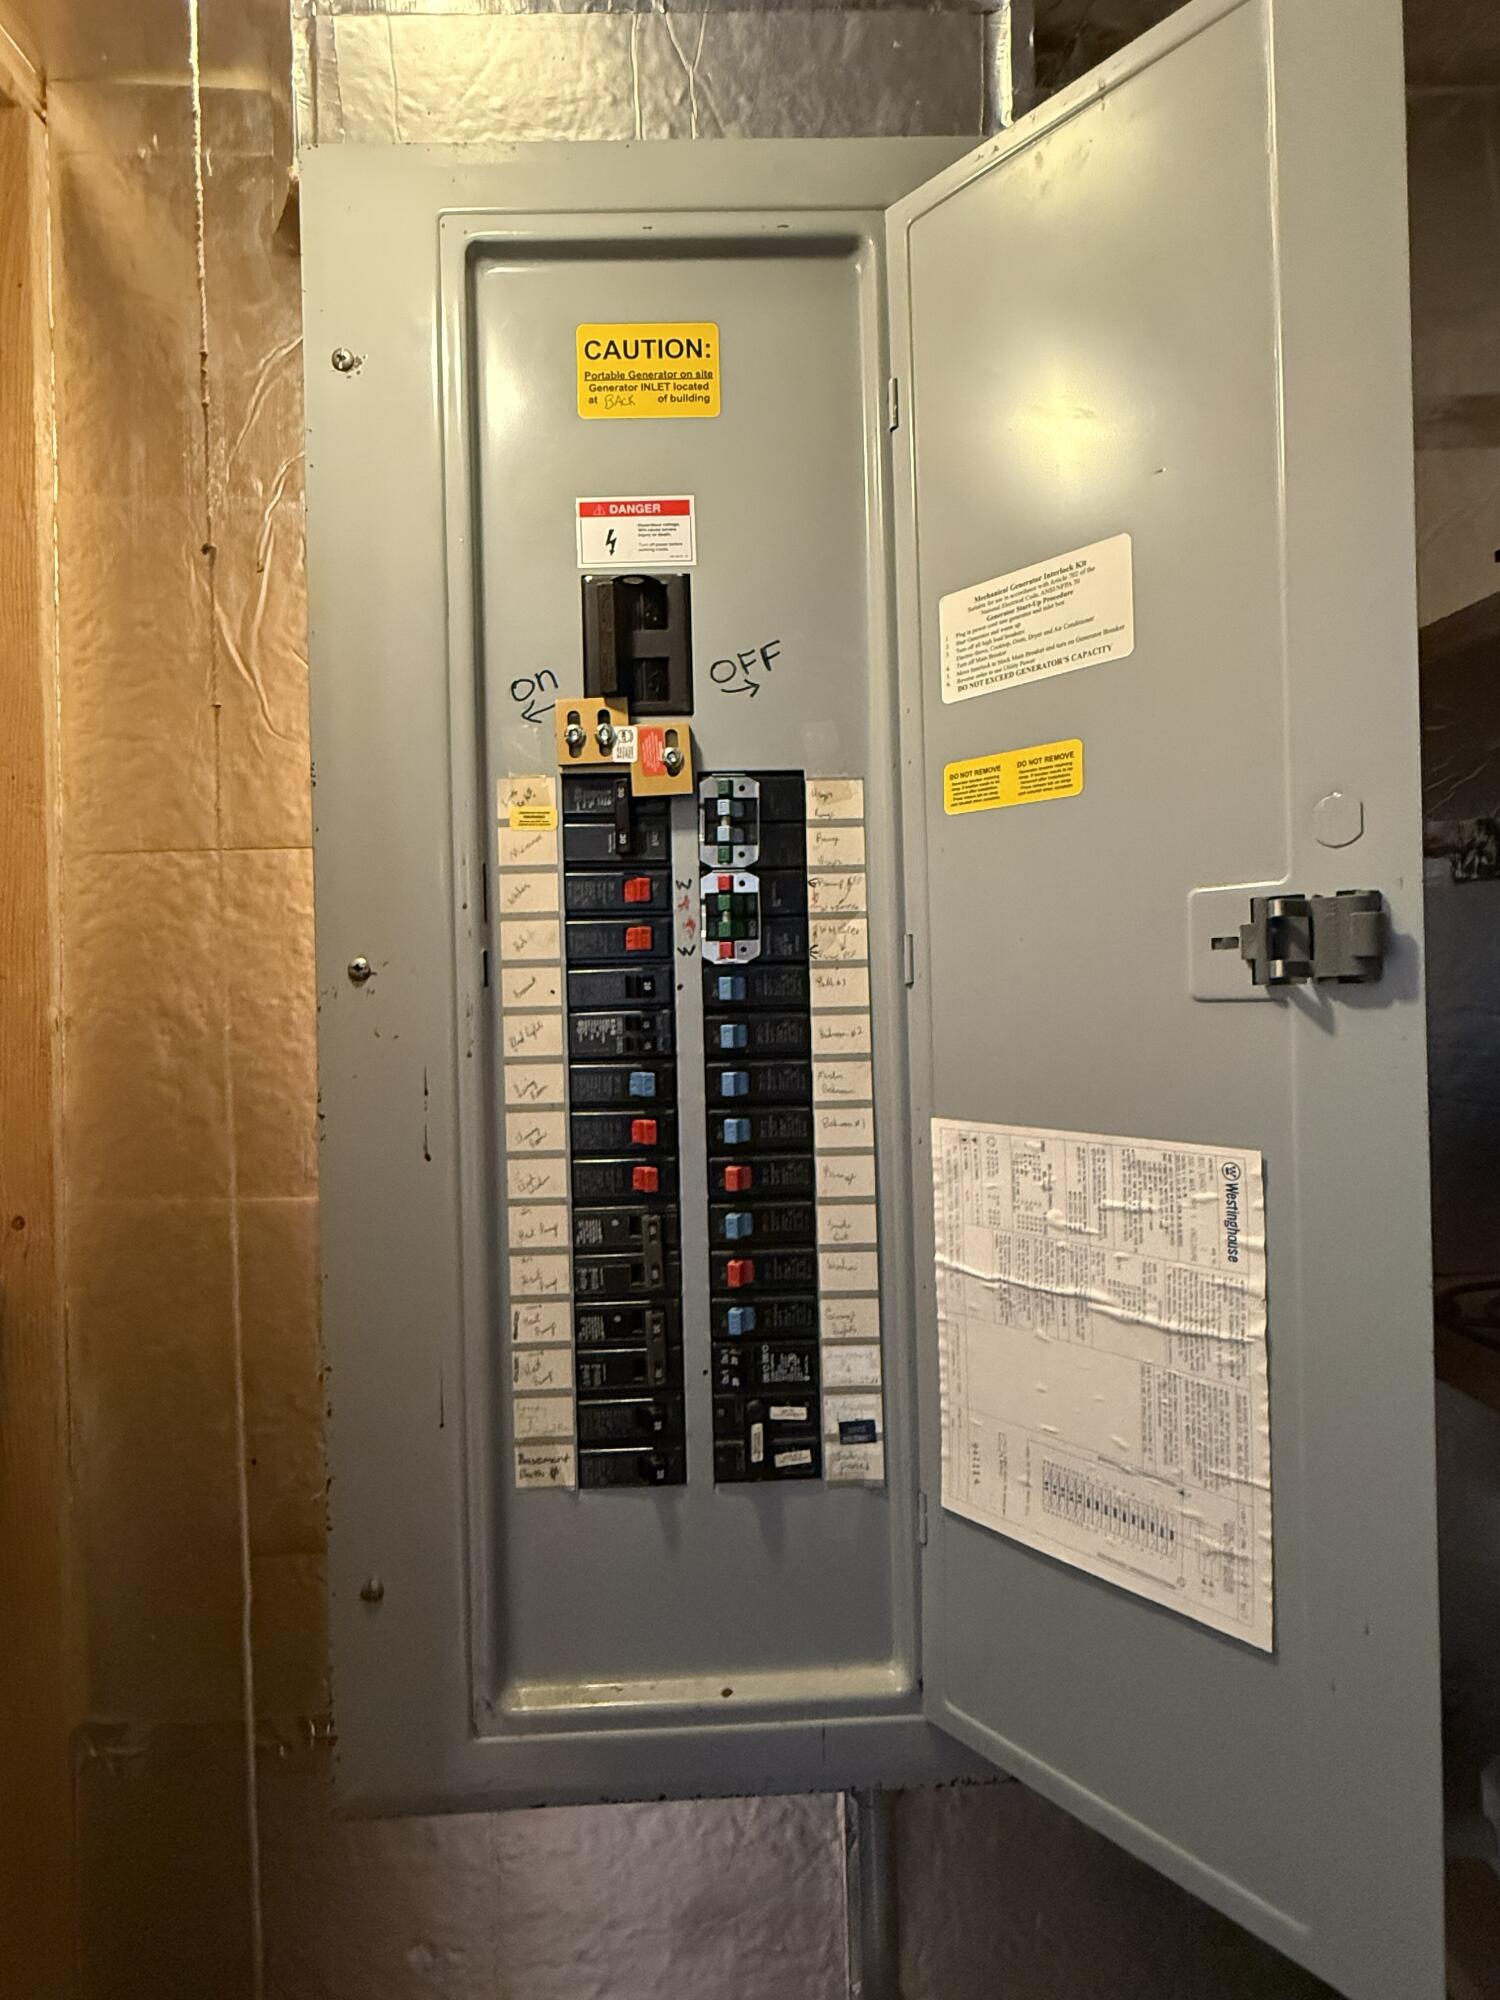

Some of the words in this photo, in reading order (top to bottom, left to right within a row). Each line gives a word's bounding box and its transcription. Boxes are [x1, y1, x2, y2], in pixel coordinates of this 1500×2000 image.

[584, 338, 711, 360] CAUTION:
[584, 371, 625, 381] Portable
[628, 370, 678, 381] Generator
[680, 371, 694, 380] on
[695, 369, 713, 380] site
[589, 383, 638, 392] Generator
[641, 383, 670, 391] INLET
[673, 382, 709, 391] located
[588, 396, 597, 404] at
[658, 394, 667, 403] of
[670, 394, 710, 404] building
[609, 503, 661, 514] DANGER
[1009, 576, 1041, 590] Generator
[1043, 563, 1073, 579] Interlock
[986, 609, 1014, 622] Generator
[1042, 590, 1073, 604] Procedure
[710, 640, 781, 684] OFF
[957, 684, 967, 692] DO
[969, 679, 983, 689] NOT
[985, 671, 1014, 684] EXCEED
[1015, 656, 1069, 676] GENERATOR'S
[1071, 644, 1111, 662] CAPACITY
[1016, 760, 1026, 768] DO
[1028, 757, 1042, 766] NOT
[1044, 751, 1074, 763] REMOVE
[959, 770, 972, 778] NOT
[973, 765, 1001, 776] REMOVE
[1224, 1183, 1240, 1263] Westinghouse
